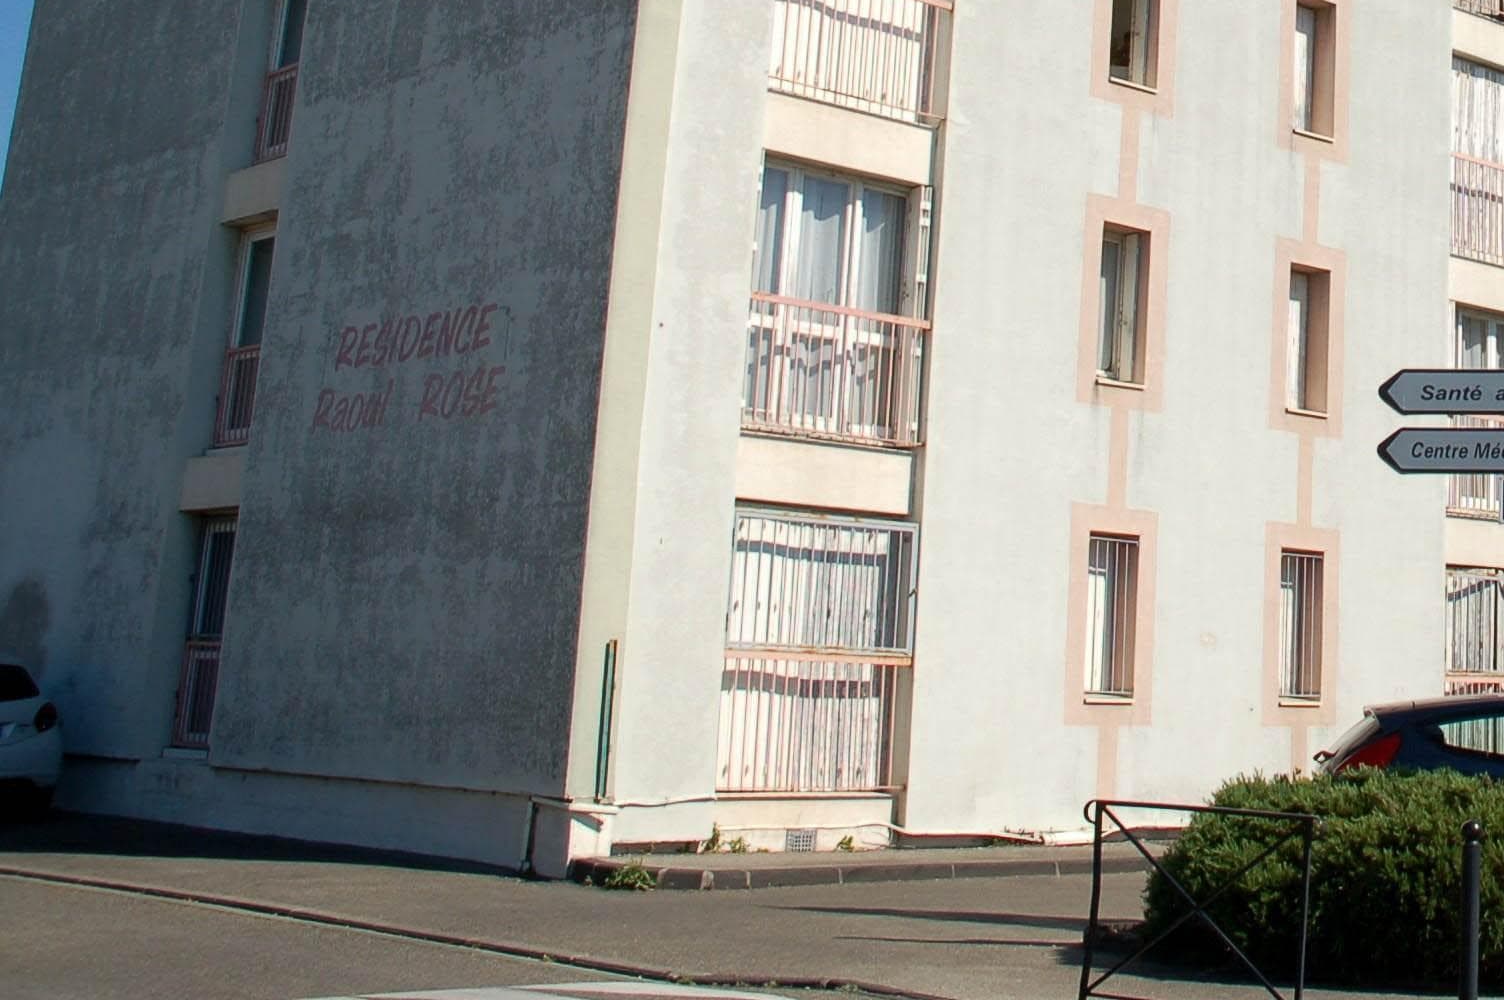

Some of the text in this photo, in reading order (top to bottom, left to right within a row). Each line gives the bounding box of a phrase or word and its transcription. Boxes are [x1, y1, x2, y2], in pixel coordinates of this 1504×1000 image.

[335, 303, 498, 372] RESIDENCE
[418, 365, 506, 422] ROSE
[1420, 384, 1482, 402] Santé
[1411, 441, 1469, 460] Centre
